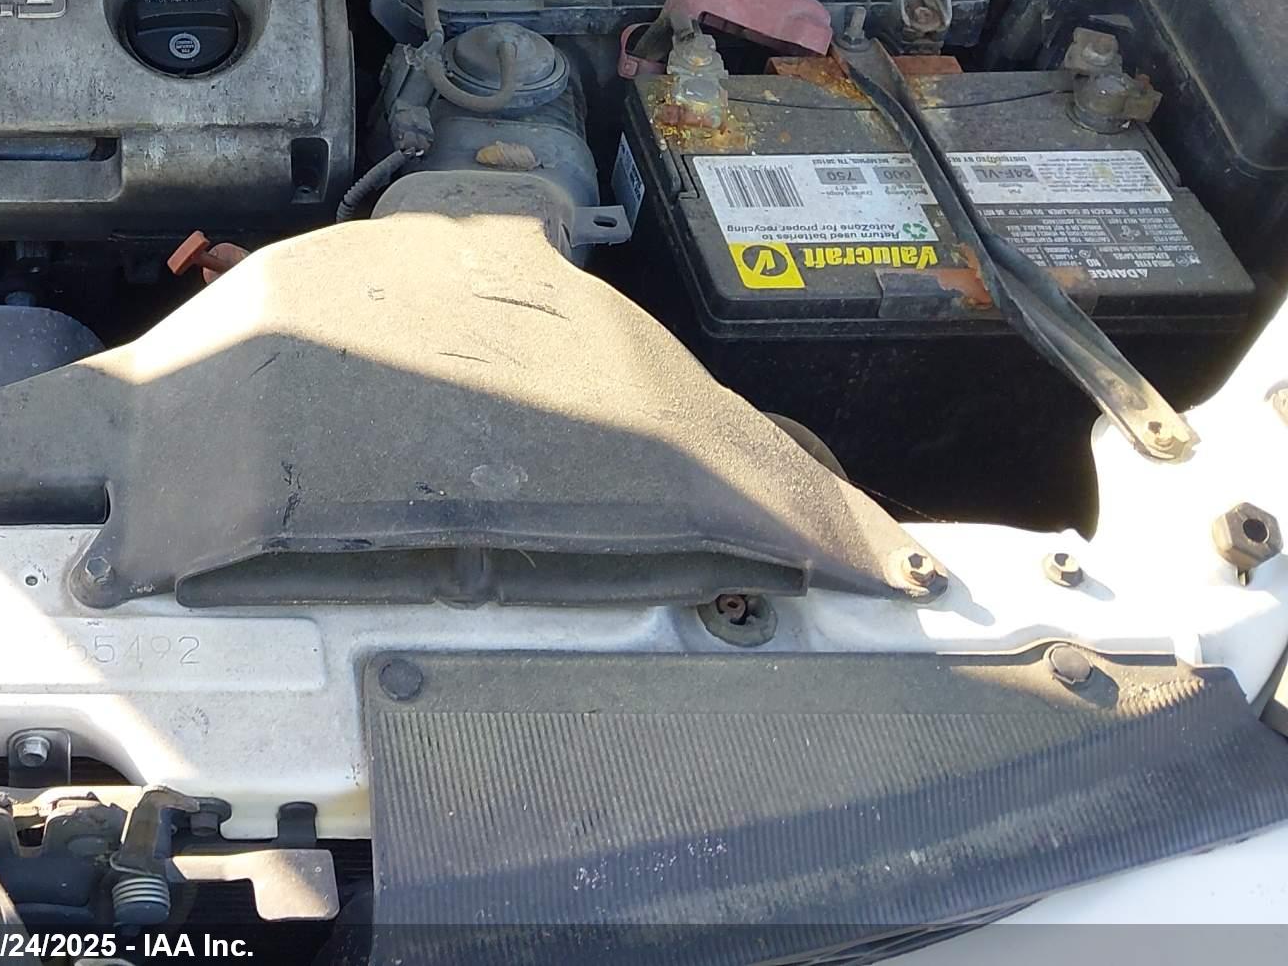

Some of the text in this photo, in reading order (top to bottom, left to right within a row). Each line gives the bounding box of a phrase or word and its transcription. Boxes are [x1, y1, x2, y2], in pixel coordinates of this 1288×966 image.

[827, 171, 856, 181] 750
[883, 170, 912, 181] 600
[975, 169, 1034, 179] 24F-VL
[727, 225, 778, 233] recycling
[818, 225, 837, 233] for
[840, 224, 896, 232] AutoZone
[776, 233, 827, 241] batteries
[830, 232, 858, 240] used
[861, 232, 900, 240] Return
[803, 246, 938, 270] Valucraft
[1086, 258, 1102, 267] NO
[1087, 268, 1139, 279] DANGE
